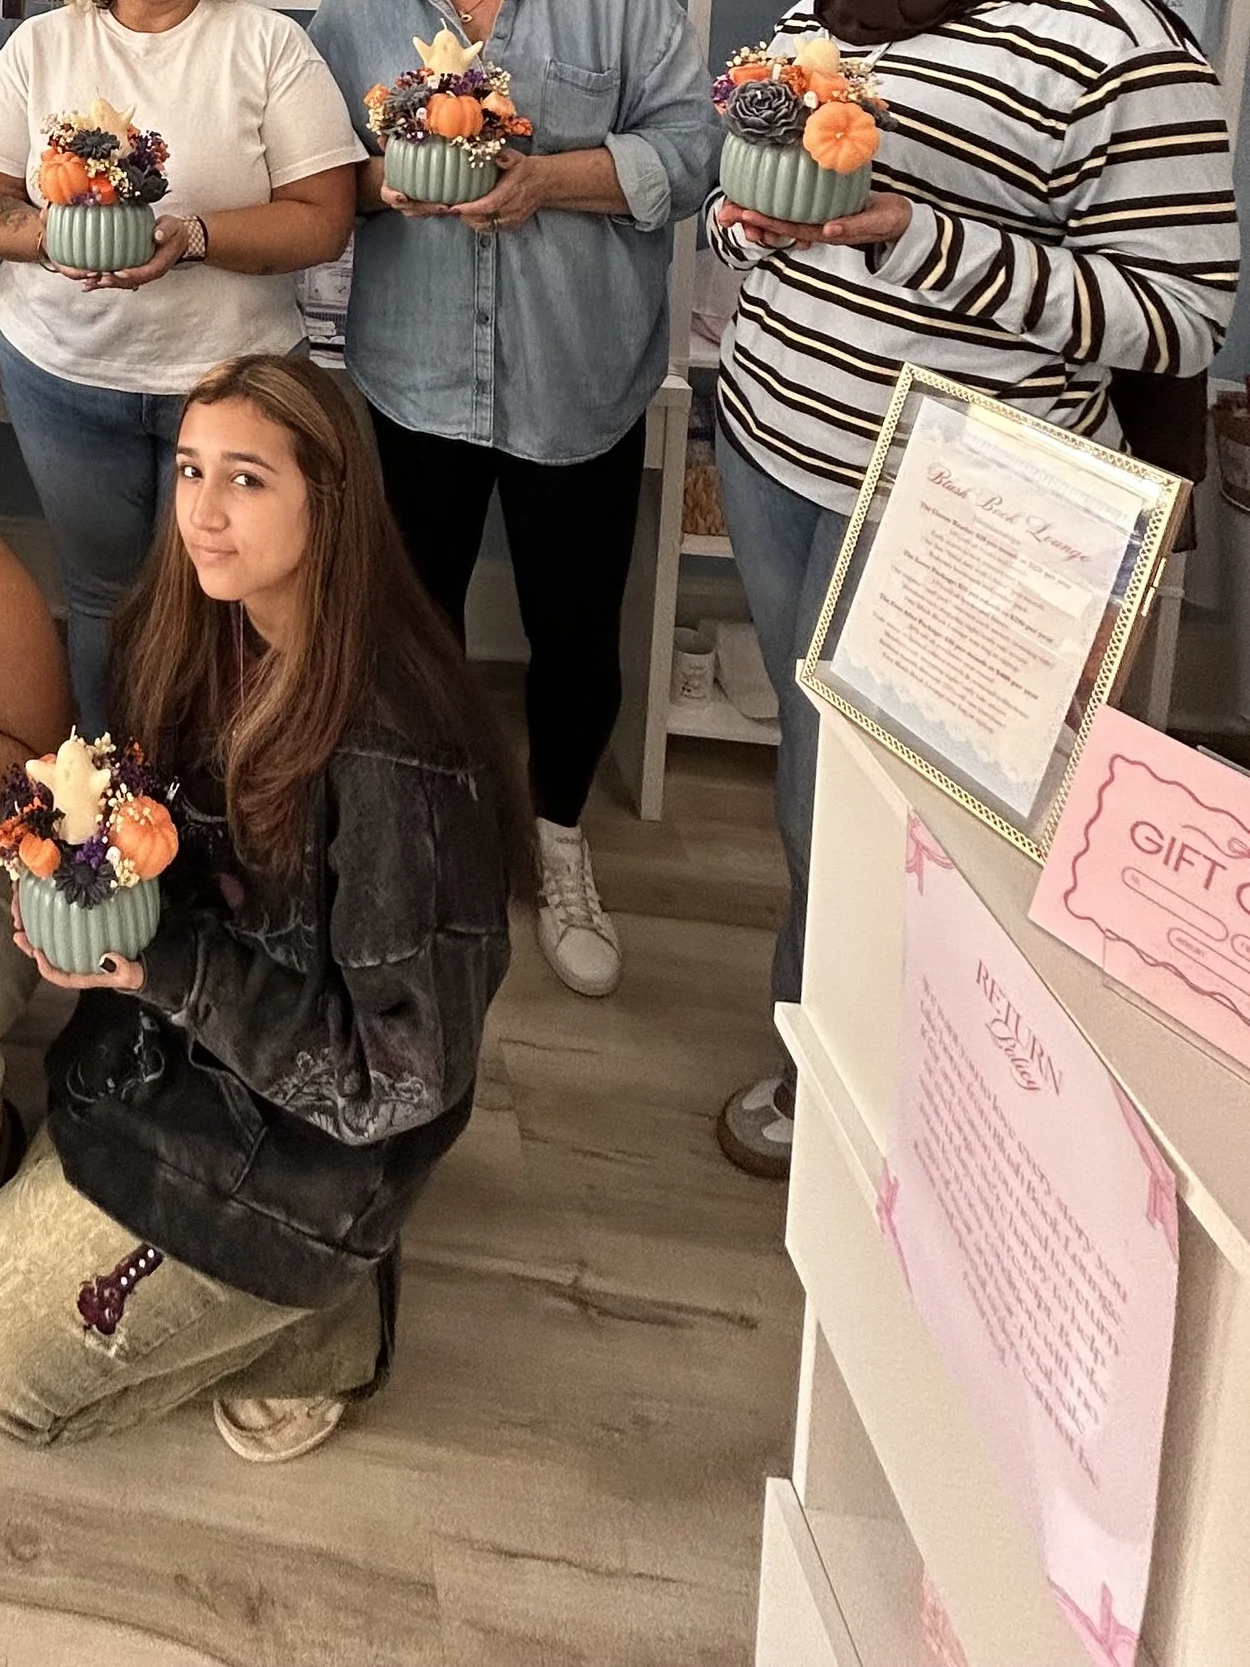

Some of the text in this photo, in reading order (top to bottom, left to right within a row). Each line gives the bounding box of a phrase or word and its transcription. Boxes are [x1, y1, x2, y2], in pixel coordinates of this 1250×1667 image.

[926, 463, 969, 499] Blush
[972, 489, 1022, 525] Book
[1025, 515, 1093, 563] Lounge
[1130, 820, 1228, 891] GIFT
[976, 959, 1062, 1096] RETURN
[985, 1018, 1041, 1091] Policy
[992, 1127, 1025, 1186] Blush
[1026, 1180, 1060, 1240] Book
[1017, 1141, 1051, 1196] every
[1057, 1197, 1091, 1252] story
[1097, 1254, 1127, 1303] you
[1008, 1212, 1047, 1282] happy
[1015, 1197, 1049, 1252] need
[1068, 1278, 1119, 1356] return
[1019, 1325, 1053, 1386] Final
[1055, 1386, 1085, 1434] sale
[1043, 1334, 1074, 1388] with
